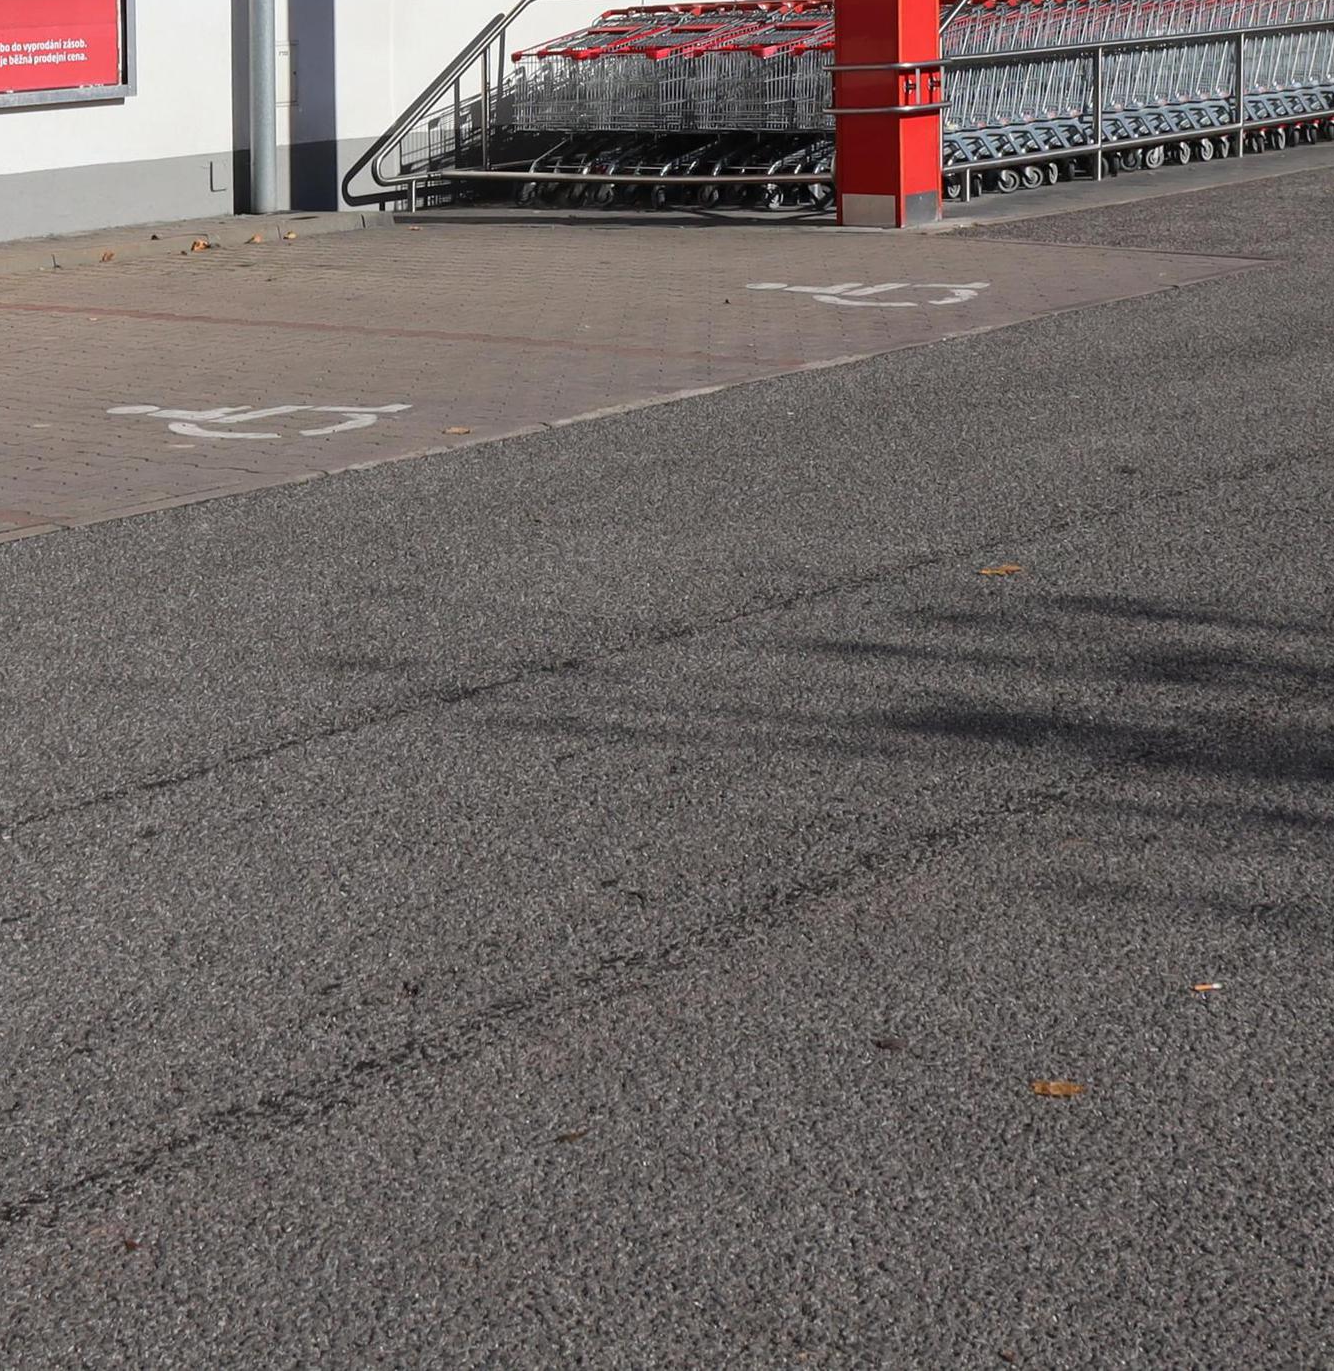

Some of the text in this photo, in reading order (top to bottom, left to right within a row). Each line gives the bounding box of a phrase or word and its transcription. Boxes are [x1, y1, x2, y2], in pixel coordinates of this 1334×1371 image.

[11, 41, 22, 52] do
[23, 38, 62, 53] vyprodání
[63, 38, 87, 48] zásob.
[0, 56, 7, 67] je
[9, 54, 32, 66] běžná
[34, 51, 66, 64] prodejní
[67, 51, 87, 61] cena.
